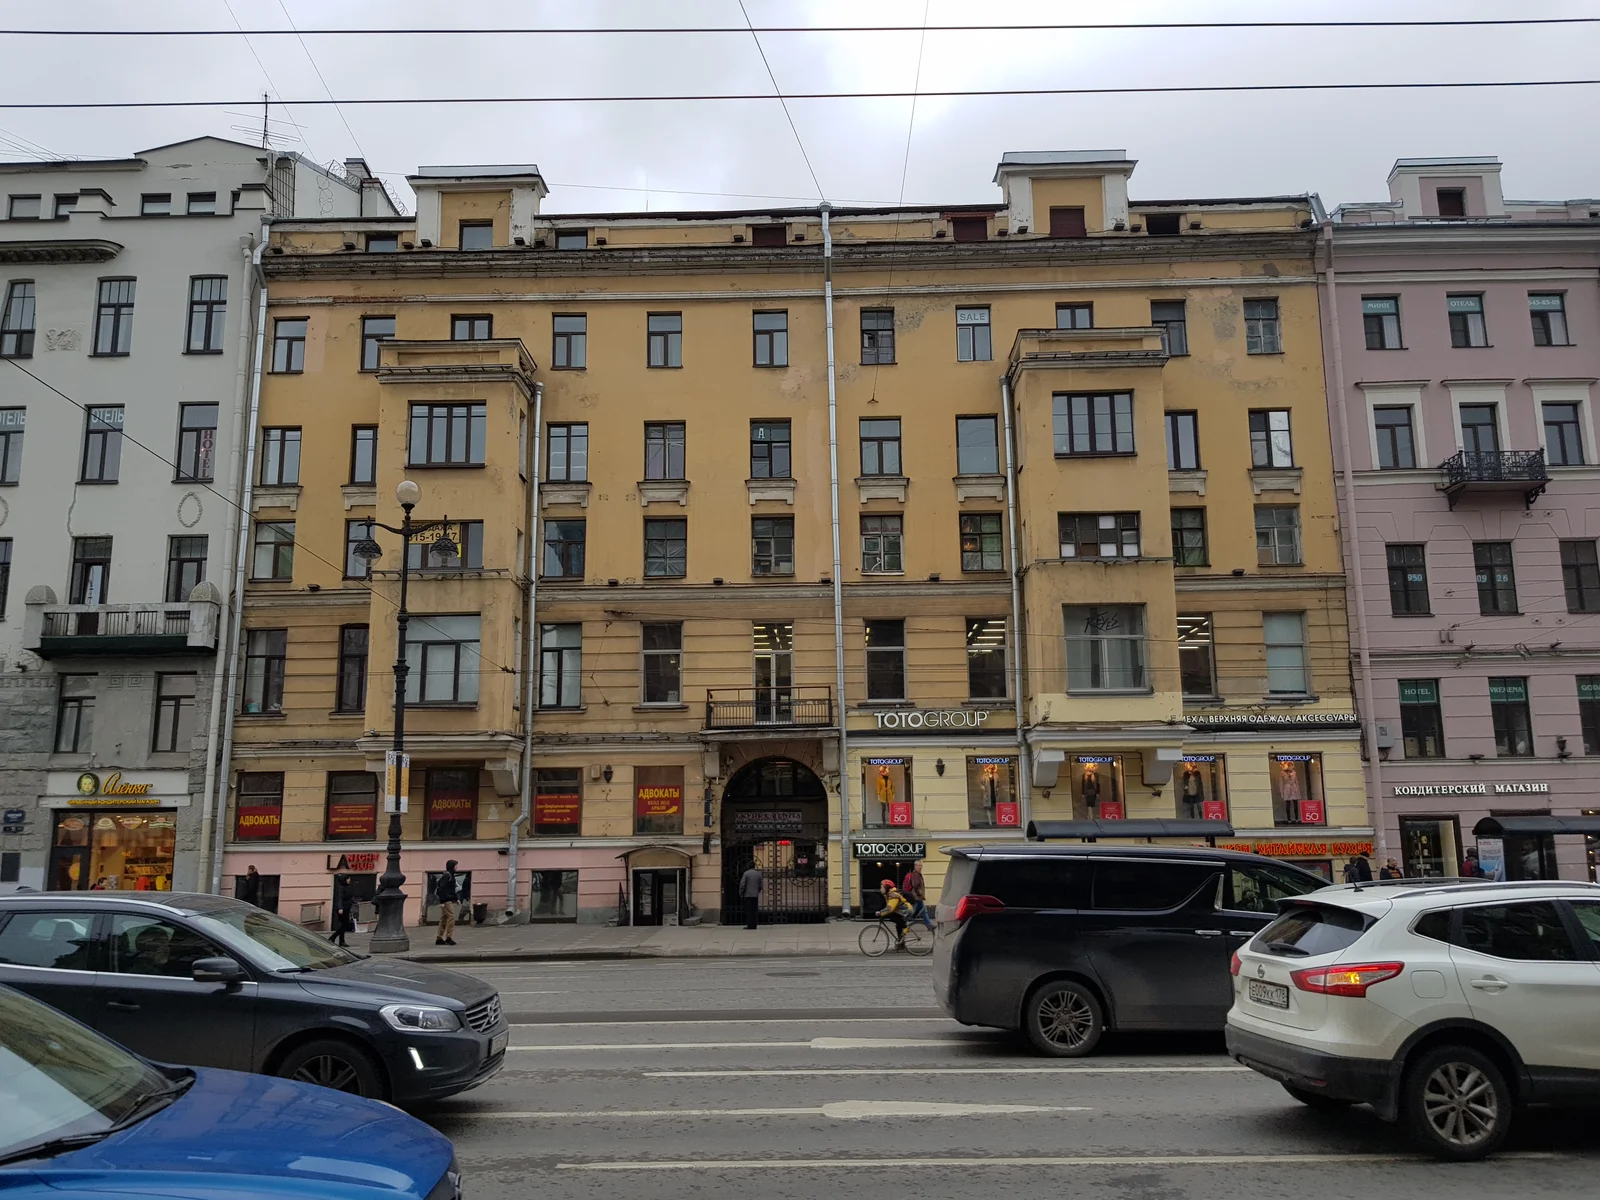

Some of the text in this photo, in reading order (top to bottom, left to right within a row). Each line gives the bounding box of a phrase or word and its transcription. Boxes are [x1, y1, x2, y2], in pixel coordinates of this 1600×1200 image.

[959, 312, 986, 321] SALE
[91, 408, 124, 423] ОТЕЛЬ
[202, 430, 213, 478] HOTEL
[1404, 688, 1431, 696] HOTEL
[874, 710, 989, 727] TOTOGROUP
[1209, 715, 1248, 723] ВЕРХНЯЯ
[1295, 714, 1358, 722] АКСЕССУАРЫ
[639, 788, 680, 799] АДВОКАТЫ
[1395, 783, 1549, 796] КОНДИТЕРСКИЙ МАГАЗИН
[432, 799, 472, 810] АДВОКАТЫ
[239, 815, 280, 826] АДВОКАТЫ
[855, 842, 925, 854] TOTOGROUP
[1256, 842, 1327, 855] КИТАЙСКАЯ
[1332, 841, 1373, 854] КУХНЯ
[347, 853, 379, 862] NIGHT
[350, 862, 375, 870] CLUB
